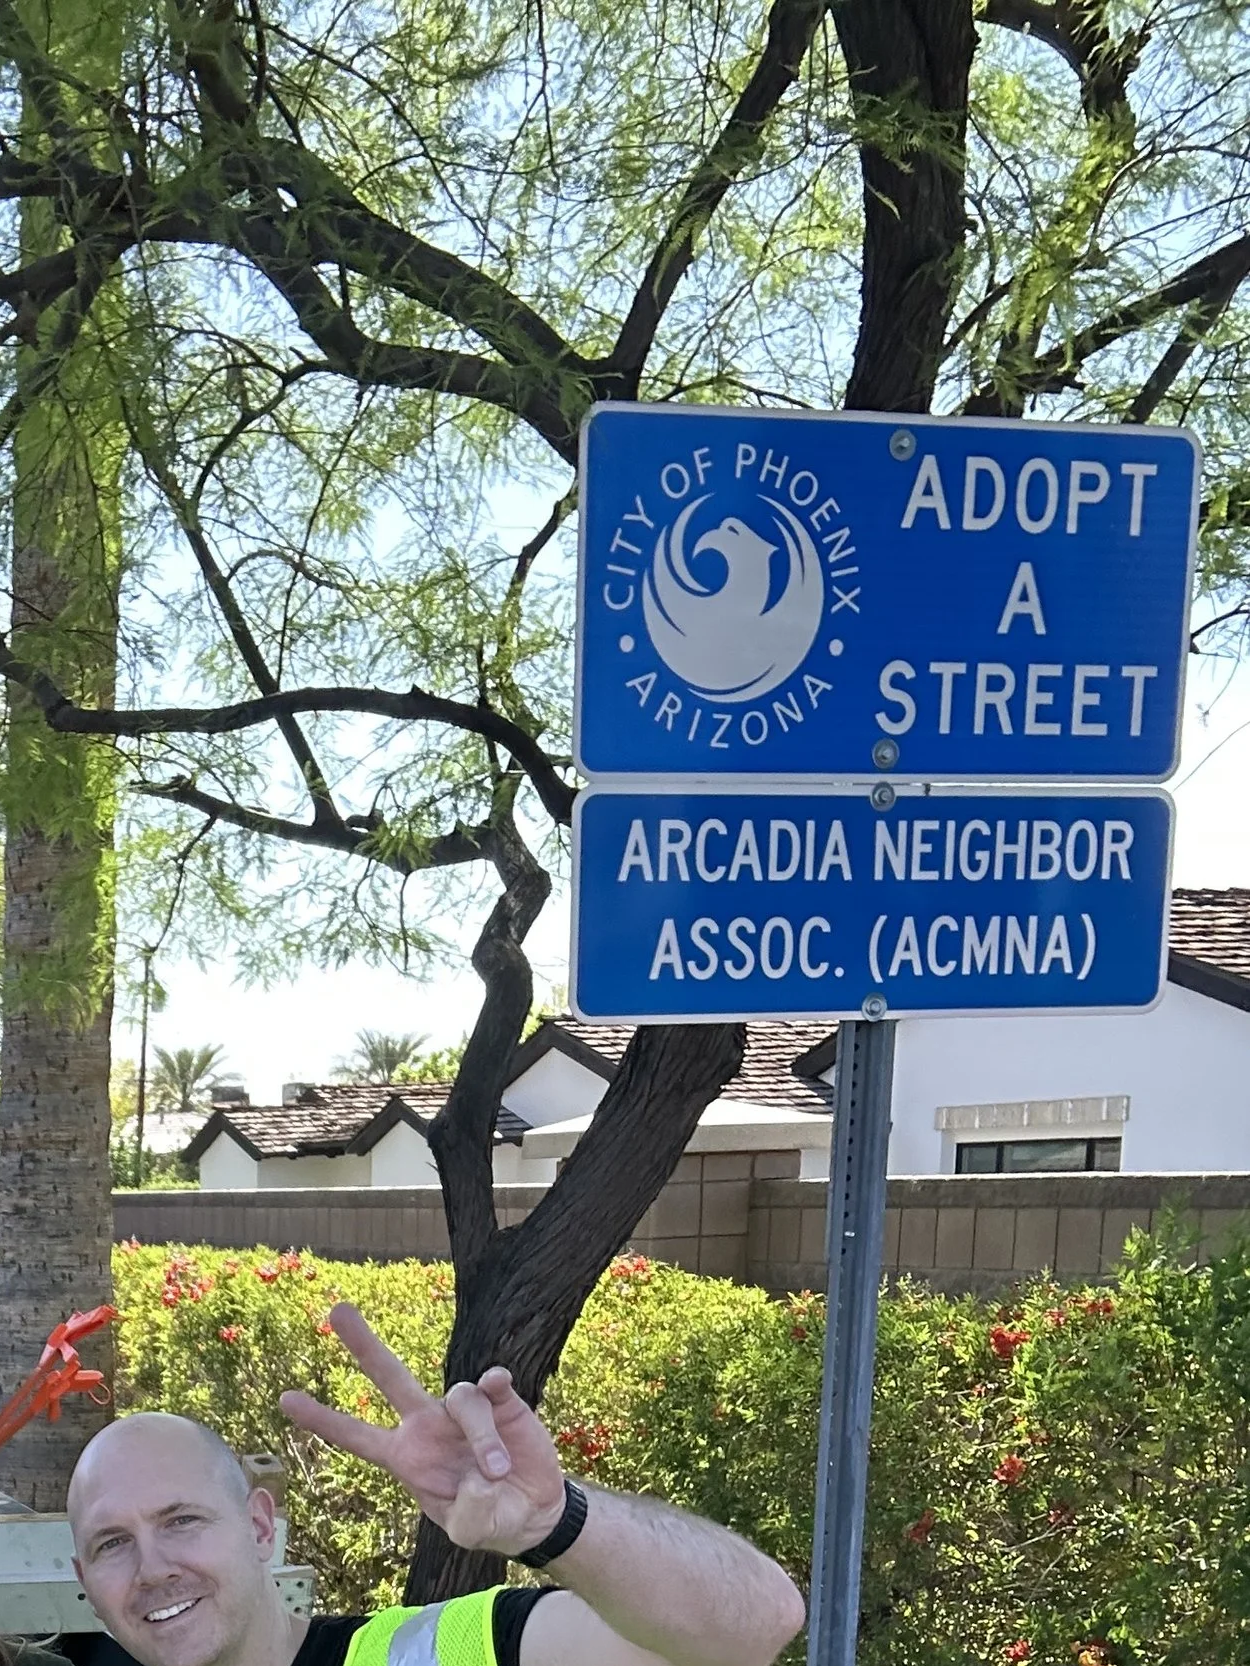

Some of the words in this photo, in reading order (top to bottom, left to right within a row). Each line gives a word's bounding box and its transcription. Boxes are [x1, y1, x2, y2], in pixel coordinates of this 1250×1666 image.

[603, 494, 655, 611] CITY
[660, 447, 713, 499] OF
[734, 443, 862, 615] PHOENIX
[900, 453, 1158, 537] ADOPT
[996, 561, 1047, 636] A
[624, 671, 834, 749] ARIZONA
[874, 659, 1158, 737] STREET
[616, 818, 853, 882] ARCADIA
[872, 818, 1136, 881] NEIGHBOR
[648, 916, 845, 981] ASSOC.
[868, 913, 1097, 984] (ACMNA)
